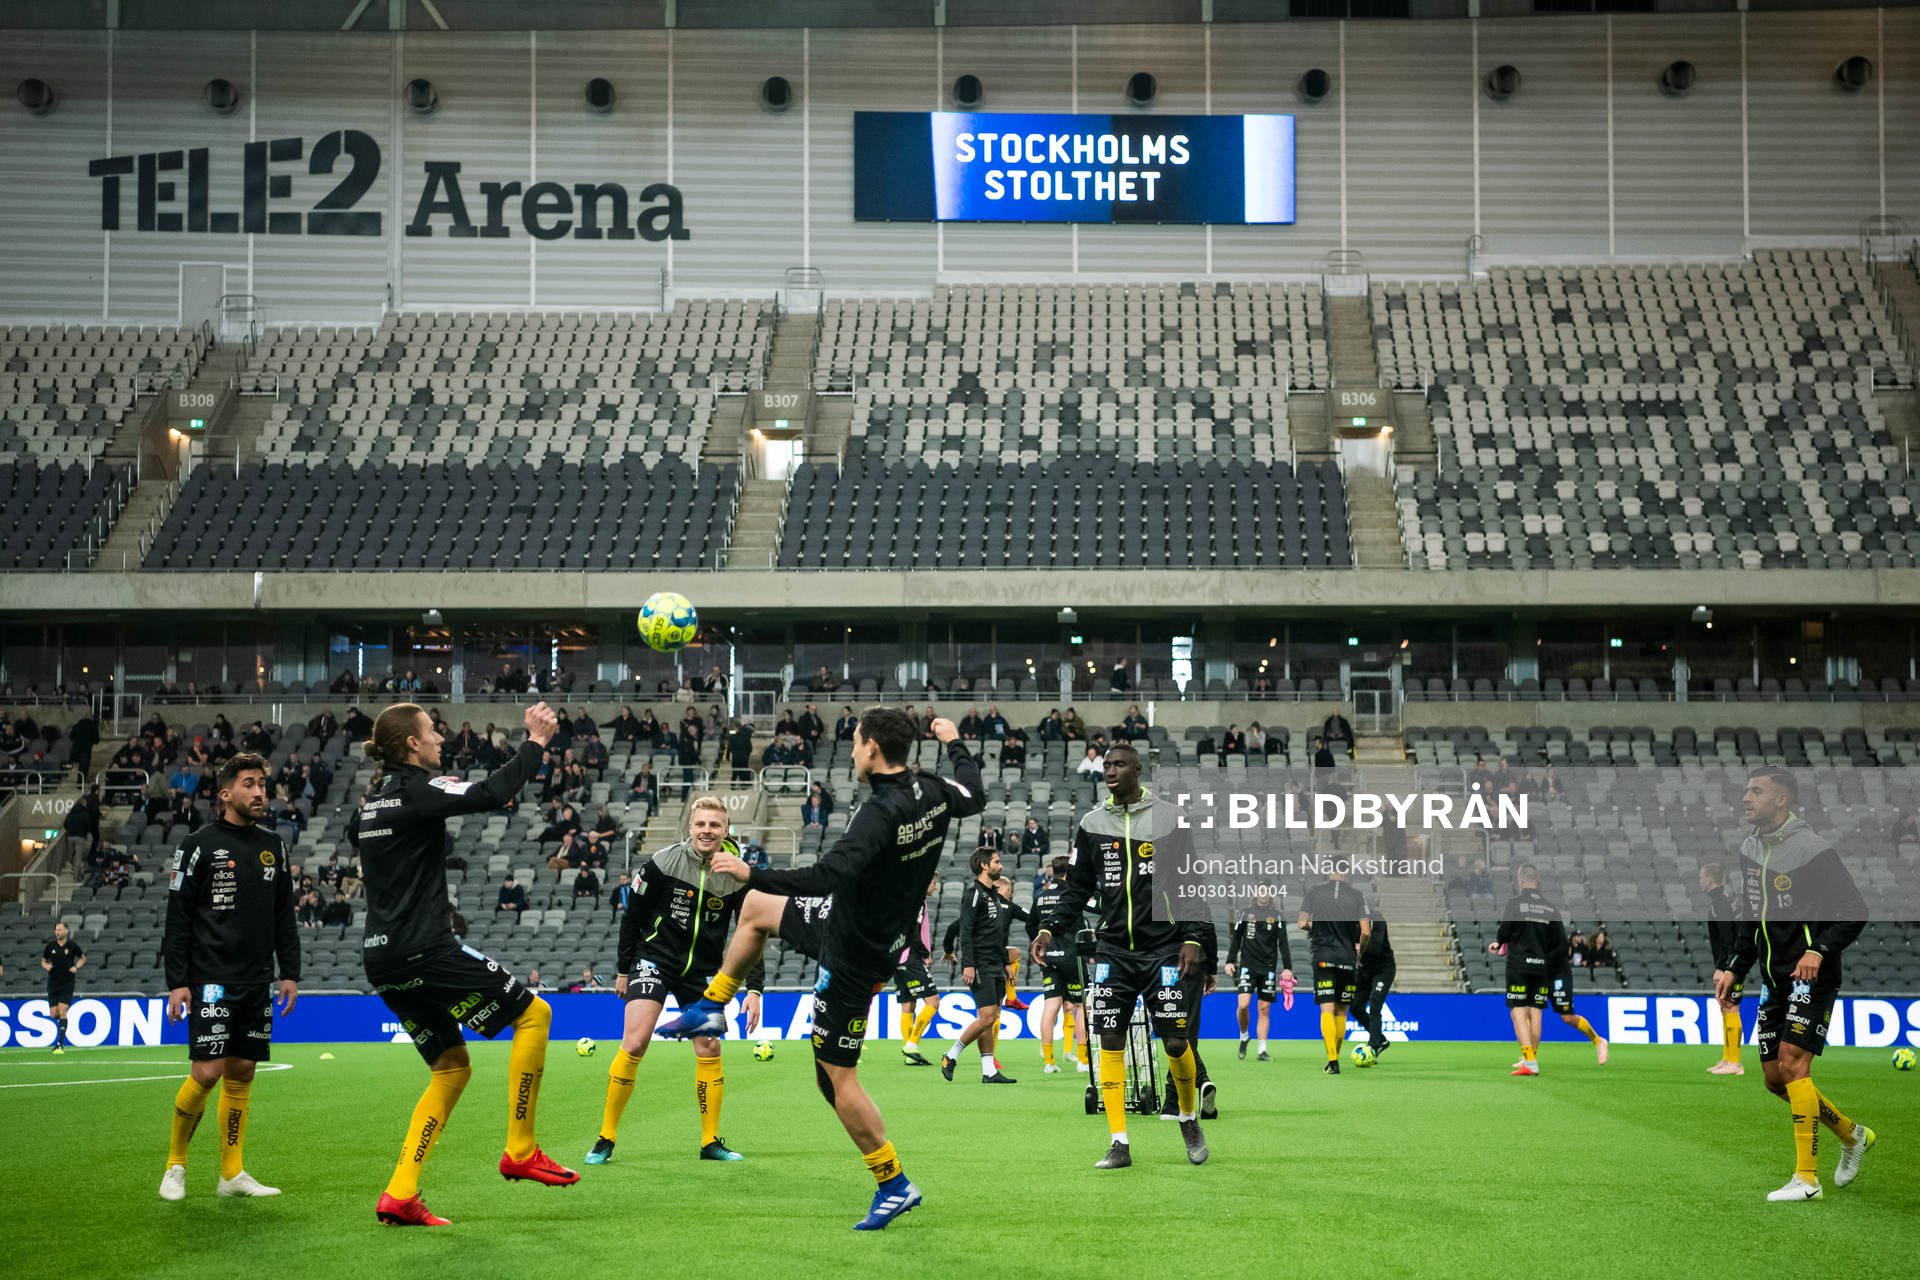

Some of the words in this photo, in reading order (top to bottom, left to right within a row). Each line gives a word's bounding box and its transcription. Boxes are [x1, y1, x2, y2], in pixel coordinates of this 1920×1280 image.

[955, 132, 1190, 165] STOCKHOLMS
[89, 130, 381, 236] TELE2
[405, 161, 690, 241] Arena
[984, 170, 1161, 201] STOLTHET
[180, 394, 214, 408] B308
[764, 394, 799, 409] B307
[1341, 392, 1377, 407] B306
[32, 799, 74, 815] A108
[263, 867, 275, 881] 27
[1138, 861, 1156, 875] 26
[1777, 893, 1793, 908] 13
[641, 983, 655, 994] 17
[1158, 987, 1183, 1000] ellos
[201, 1003, 230, 1017] ellos
[449, 994, 481, 1019] EAB
[0, 998, 163, 1048] SON
[1103, 1015, 1117, 1028] 26
[209, 1041, 225, 1055] 27
[516, 1072, 534, 1121] FRISTADS
[227, 1108, 242, 1147] FRISTADS
[413, 1116, 439, 1164] FRISTADS
